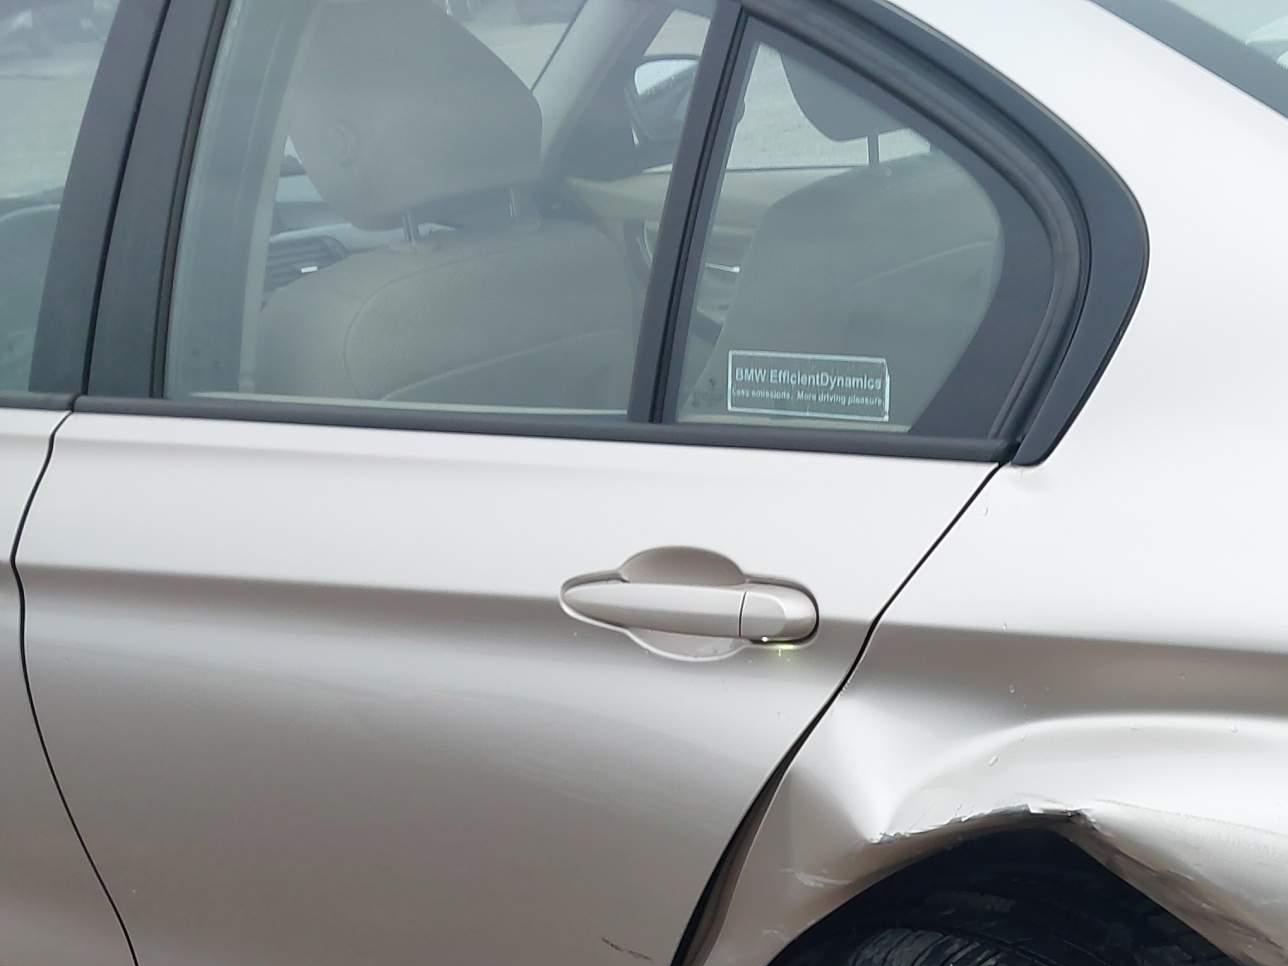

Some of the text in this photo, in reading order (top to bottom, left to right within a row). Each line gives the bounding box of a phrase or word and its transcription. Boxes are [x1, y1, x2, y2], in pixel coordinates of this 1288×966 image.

[735, 367, 882, 391] BMW EfficientDynamics
[797, 390, 816, 401] More
[818, 391, 846, 406] driving
